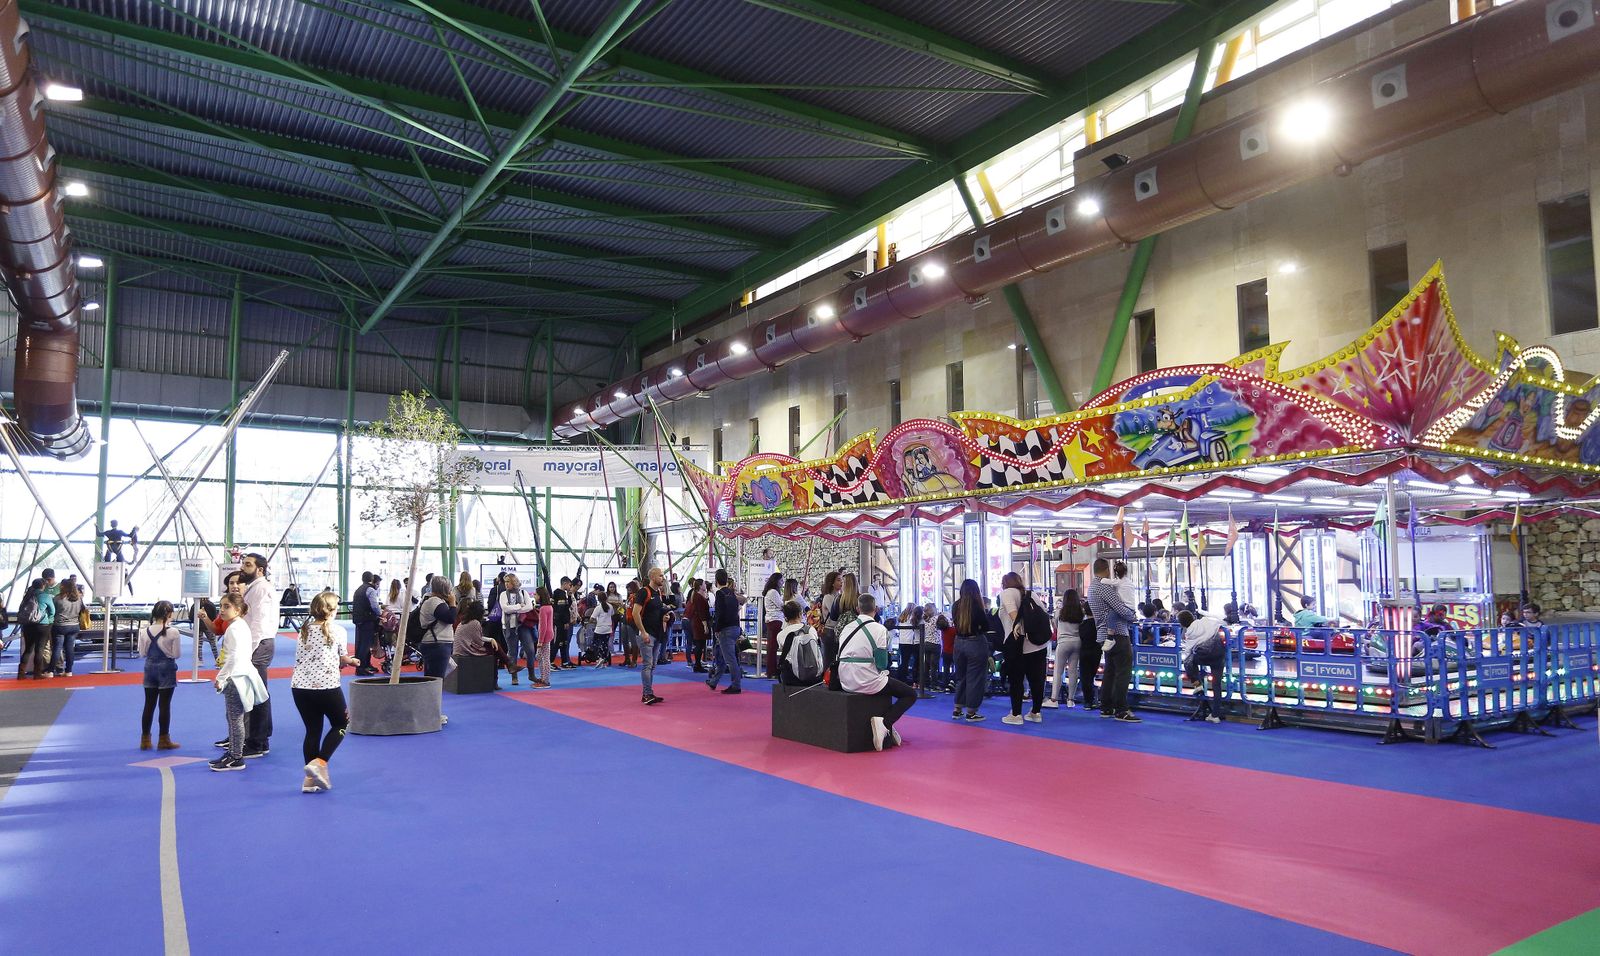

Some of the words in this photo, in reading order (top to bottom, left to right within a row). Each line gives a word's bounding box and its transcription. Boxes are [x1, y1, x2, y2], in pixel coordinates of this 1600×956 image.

[543, 459, 602, 474] mayoral
[1151, 656, 1175, 665] FYCMA
[1320, 666, 1352, 676] FYCMA
